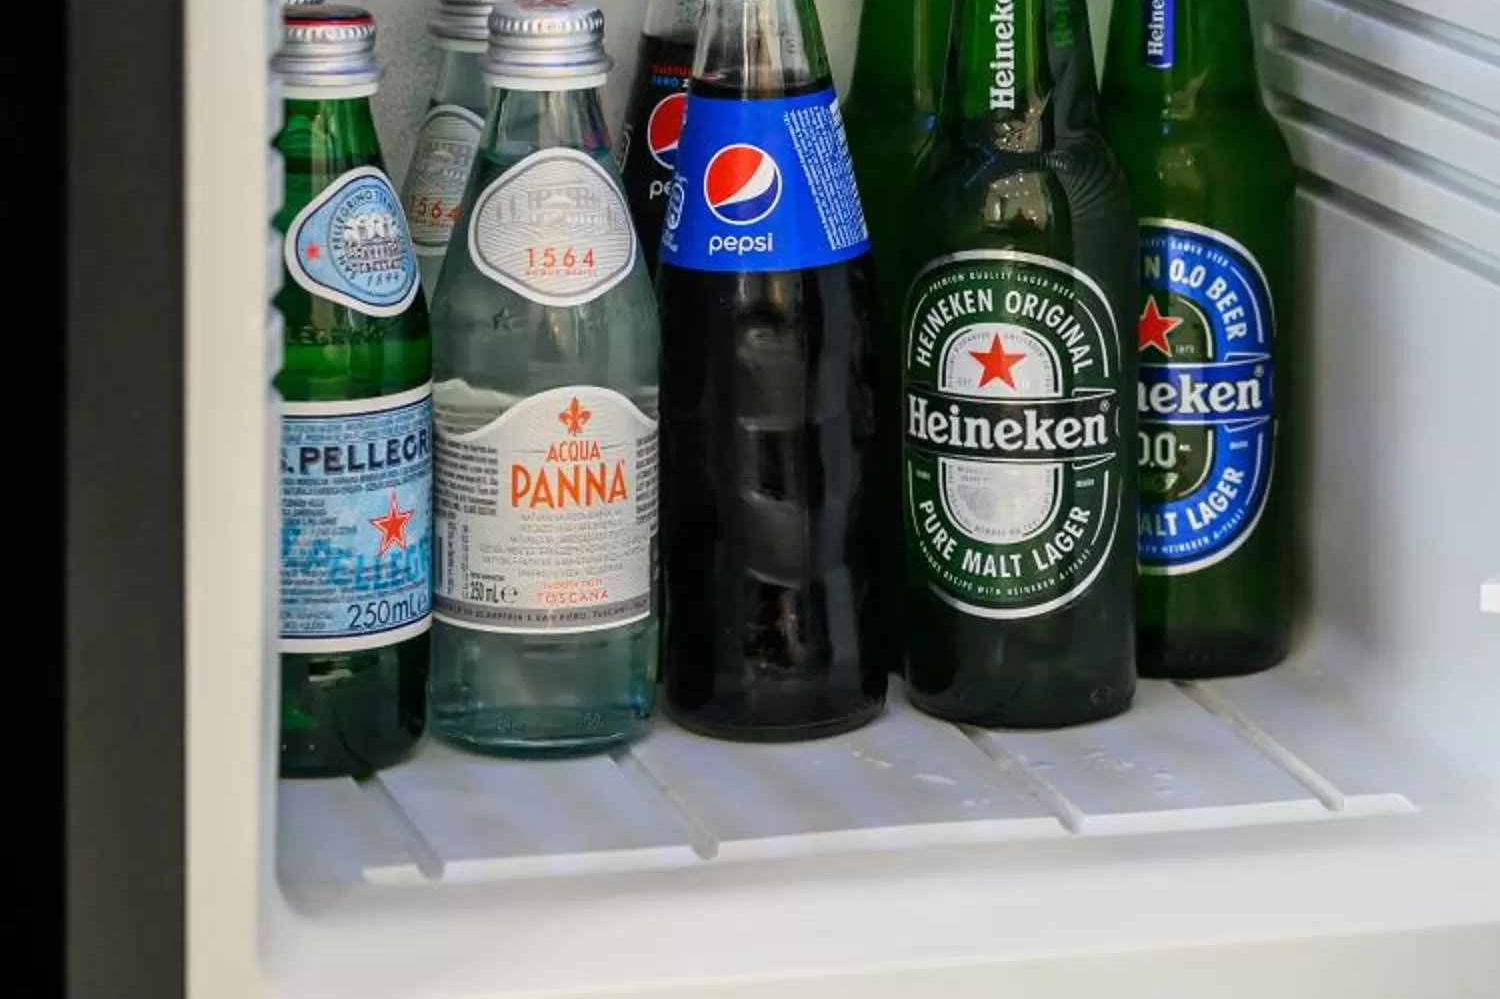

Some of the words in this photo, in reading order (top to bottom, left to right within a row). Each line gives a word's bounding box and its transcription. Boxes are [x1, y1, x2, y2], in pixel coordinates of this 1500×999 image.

[525, 248, 596, 269] 1564
[708, 232, 774, 256] pepsi
[969, 271, 1013, 282] QUALITY
[1169, 257, 1207, 289] 0.0
[1205, 276, 1248, 342] BEER
[915, 289, 993, 368] HEINEKEN
[1005, 290, 1094, 374] ORIGINAL
[908, 395, 1109, 451] Heineken
[546, 440, 601, 462] ACQUA
[511, 459, 629, 509] PANNA
[1138, 511, 1178, 537] ALT
[1185, 466, 1245, 530] LAGER
[919, 500, 958, 561] PURE
[961, 548, 1023, 578] MALT
[1031, 506, 1092, 571] LAGER
[536, 589, 609, 604] TOSCANA
